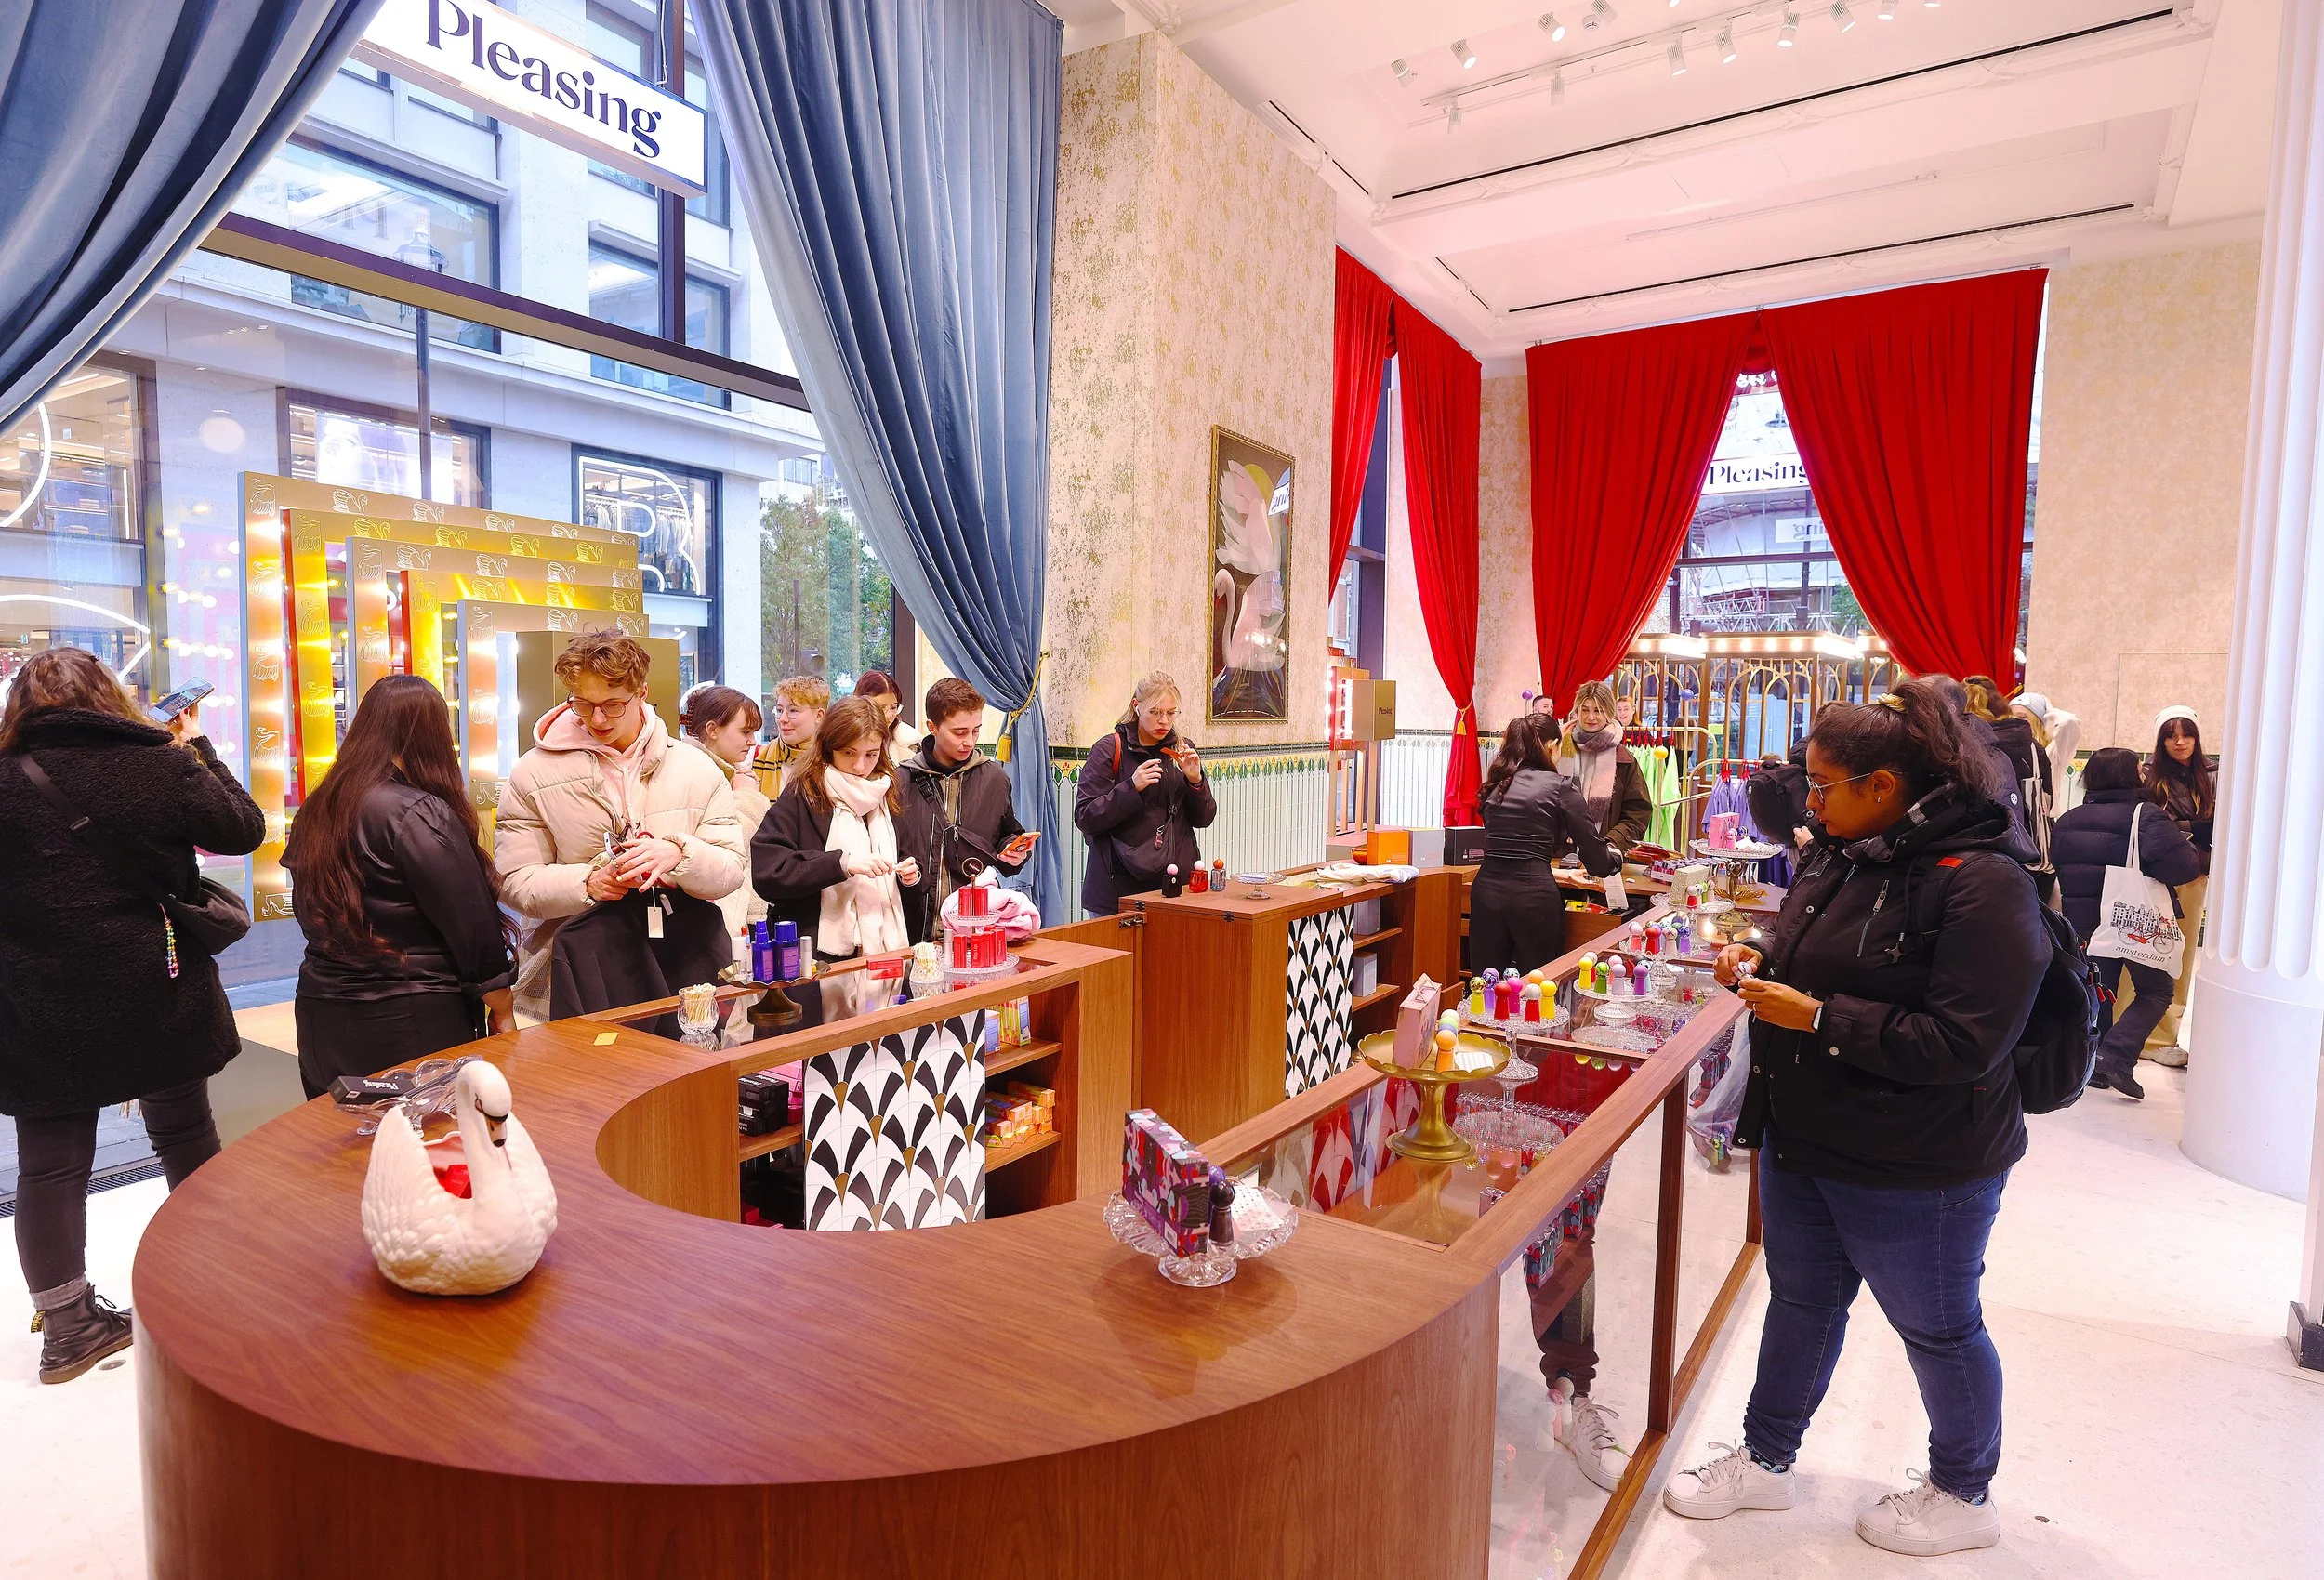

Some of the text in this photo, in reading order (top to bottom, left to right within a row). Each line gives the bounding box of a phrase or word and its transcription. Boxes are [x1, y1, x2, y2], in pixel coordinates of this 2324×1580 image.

[426, 0, 662, 158] Pleasing
[1710, 461, 1807, 485] Pleasing
[2115, 945, 2166, 963] amsterdam
